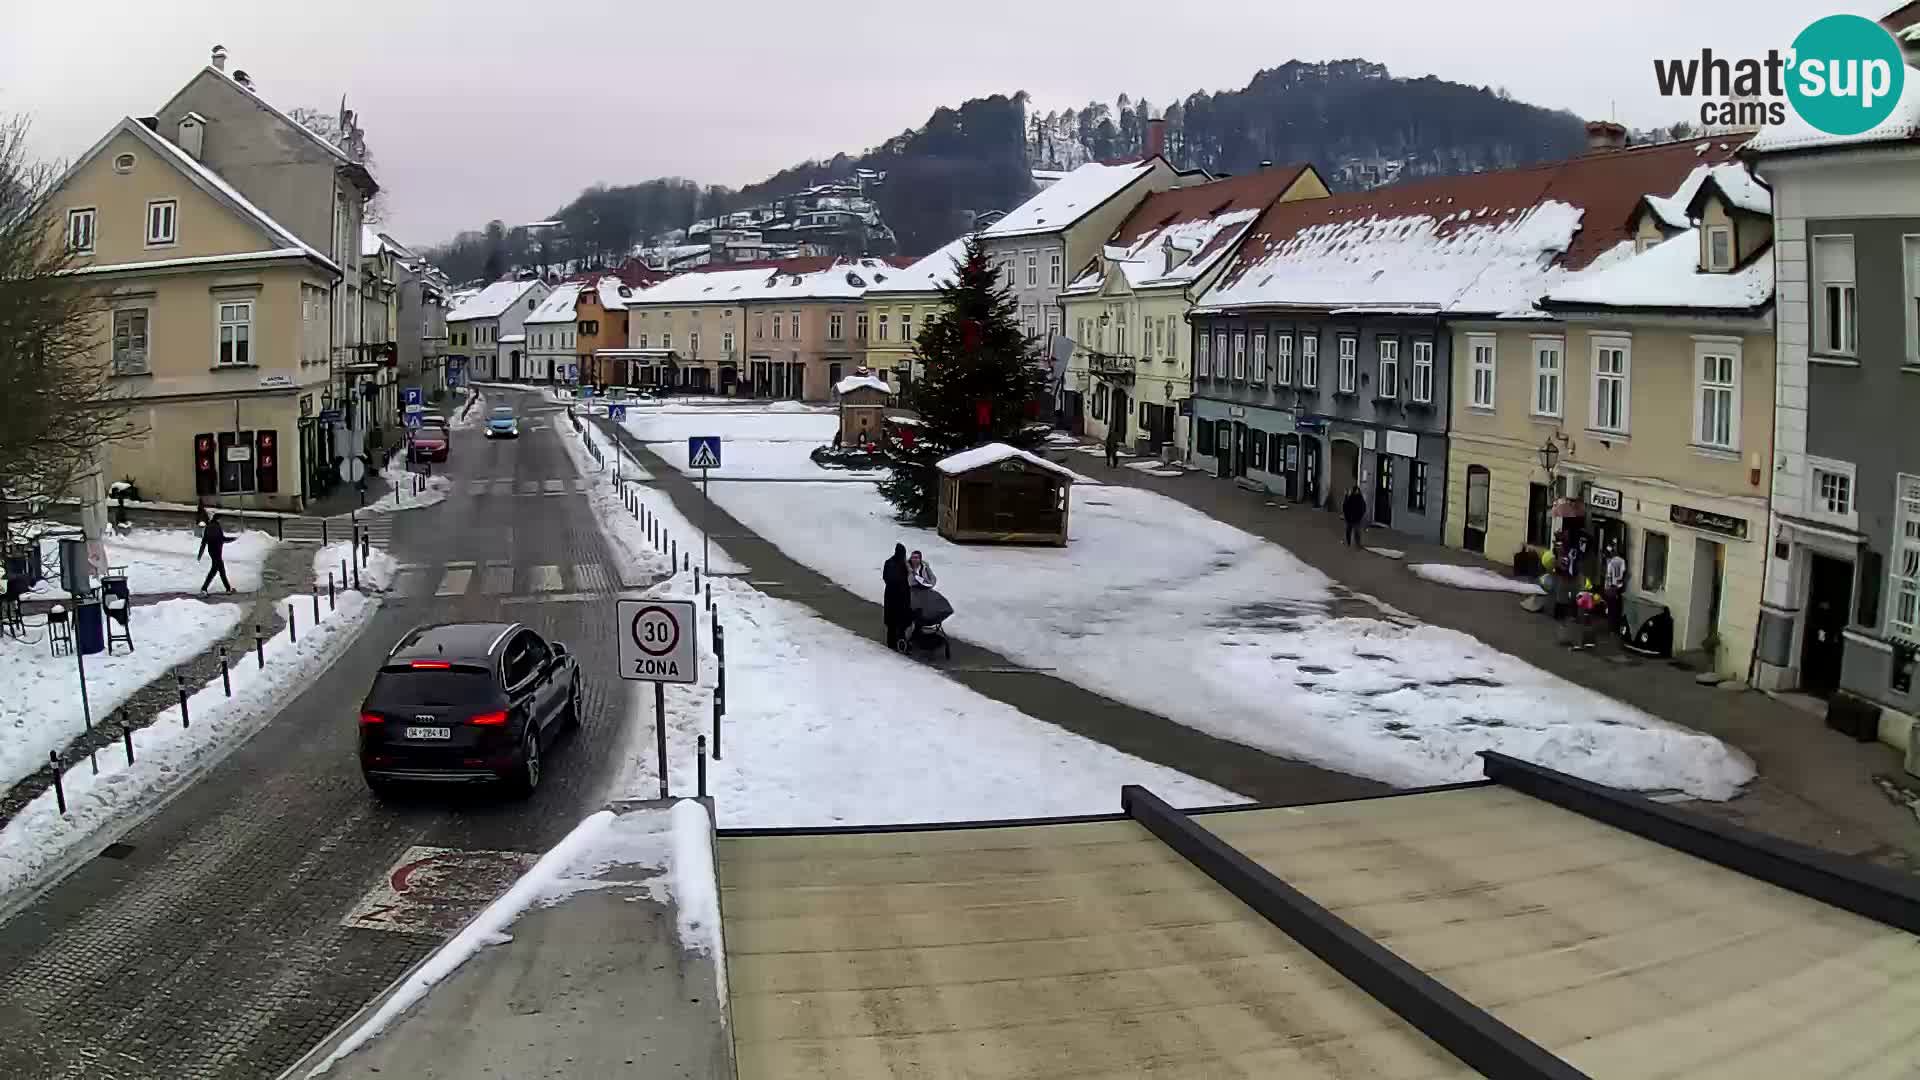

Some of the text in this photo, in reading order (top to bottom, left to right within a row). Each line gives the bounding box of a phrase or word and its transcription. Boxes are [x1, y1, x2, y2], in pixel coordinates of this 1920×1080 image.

[409, 391, 416, 401] P
[644, 621, 668, 643] 30
[634, 659, 679, 676] ZONA
